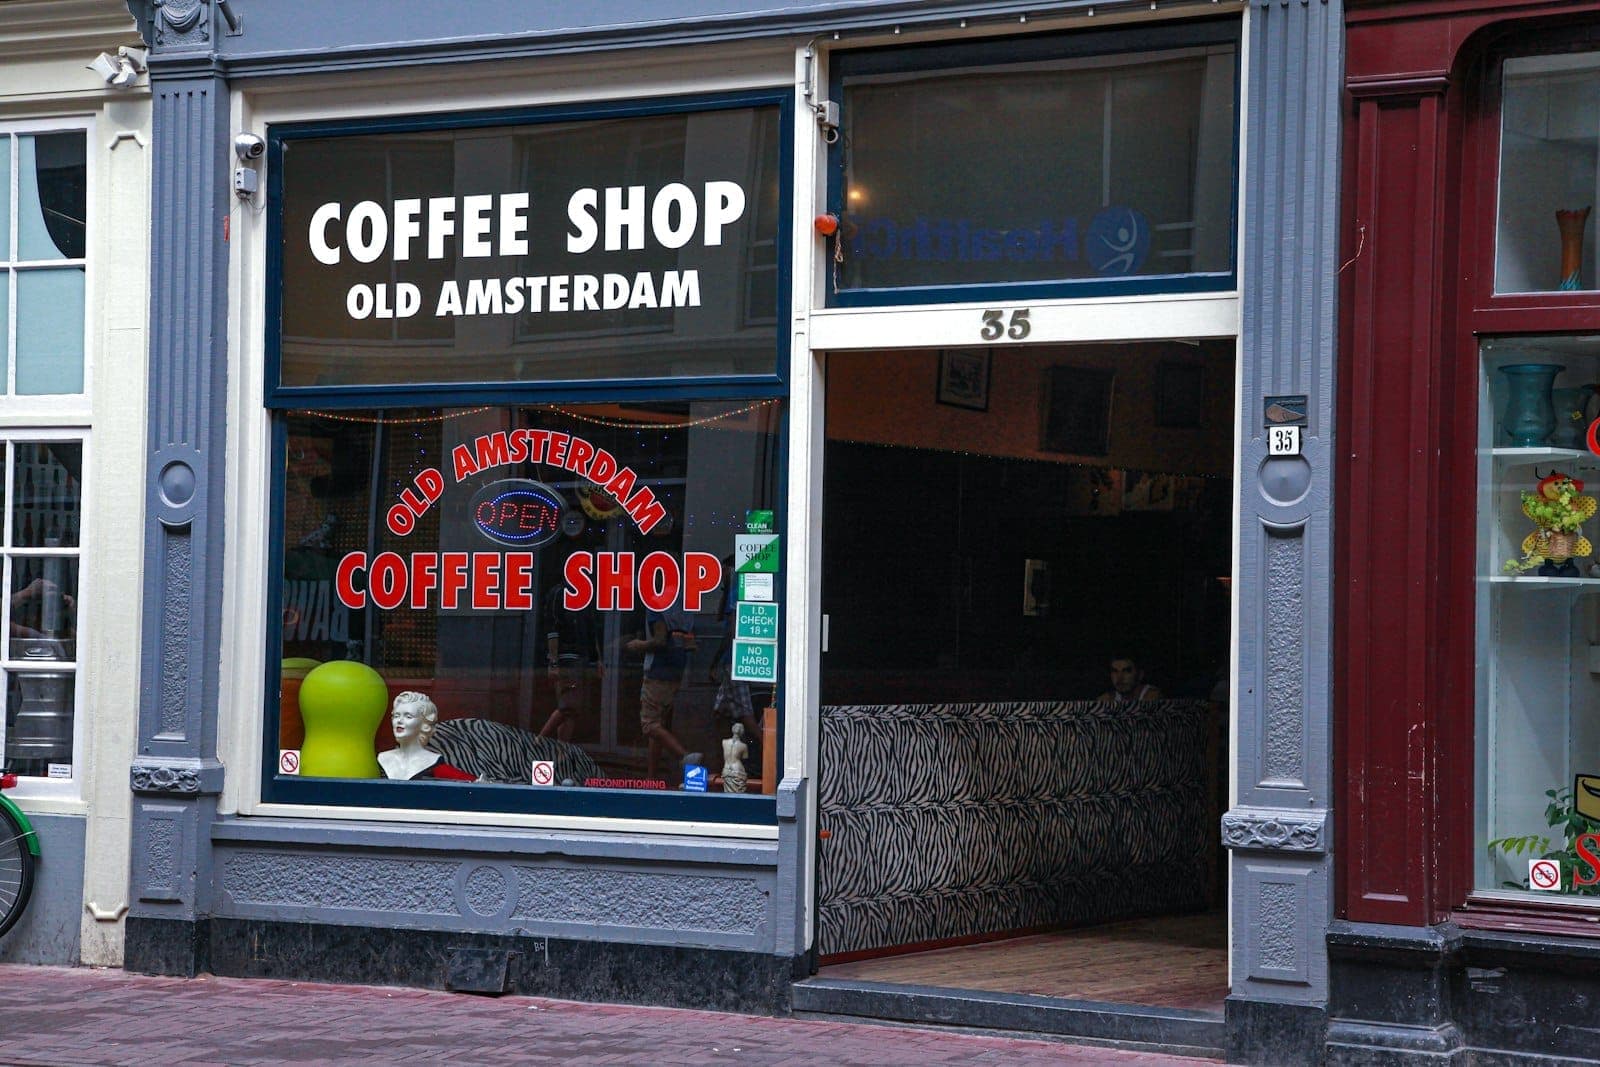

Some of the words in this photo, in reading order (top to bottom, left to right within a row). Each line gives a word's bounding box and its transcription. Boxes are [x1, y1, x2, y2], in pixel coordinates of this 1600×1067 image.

[308, 192, 529, 265] COFFEE
[567, 181, 746, 254] SHOP
[346, 283, 421, 319] OLD
[435, 270, 701, 317] AMSTERDAM
[980, 308, 1031, 340] 35
[1275, 430, 1293, 451] 35
[386, 468, 445, 536] OLD
[452, 429, 667, 535] AMSTERDAM
[475, 501, 559, 531] OPEN
[739, 544, 776, 552] COFFEE
[745, 552, 770, 561] SHOP
[336, 551, 533, 610] COFFEE
[563, 551, 722, 612] SHOP
[752, 605, 768, 615] I.D.
[740, 615, 774, 625] CHECK
[747, 646, 762, 655] NO
[741, 655, 769, 666] HARD
[737, 665, 772, 676] DRUGS
[584, 778, 667, 790] AIRCONDITIONING
